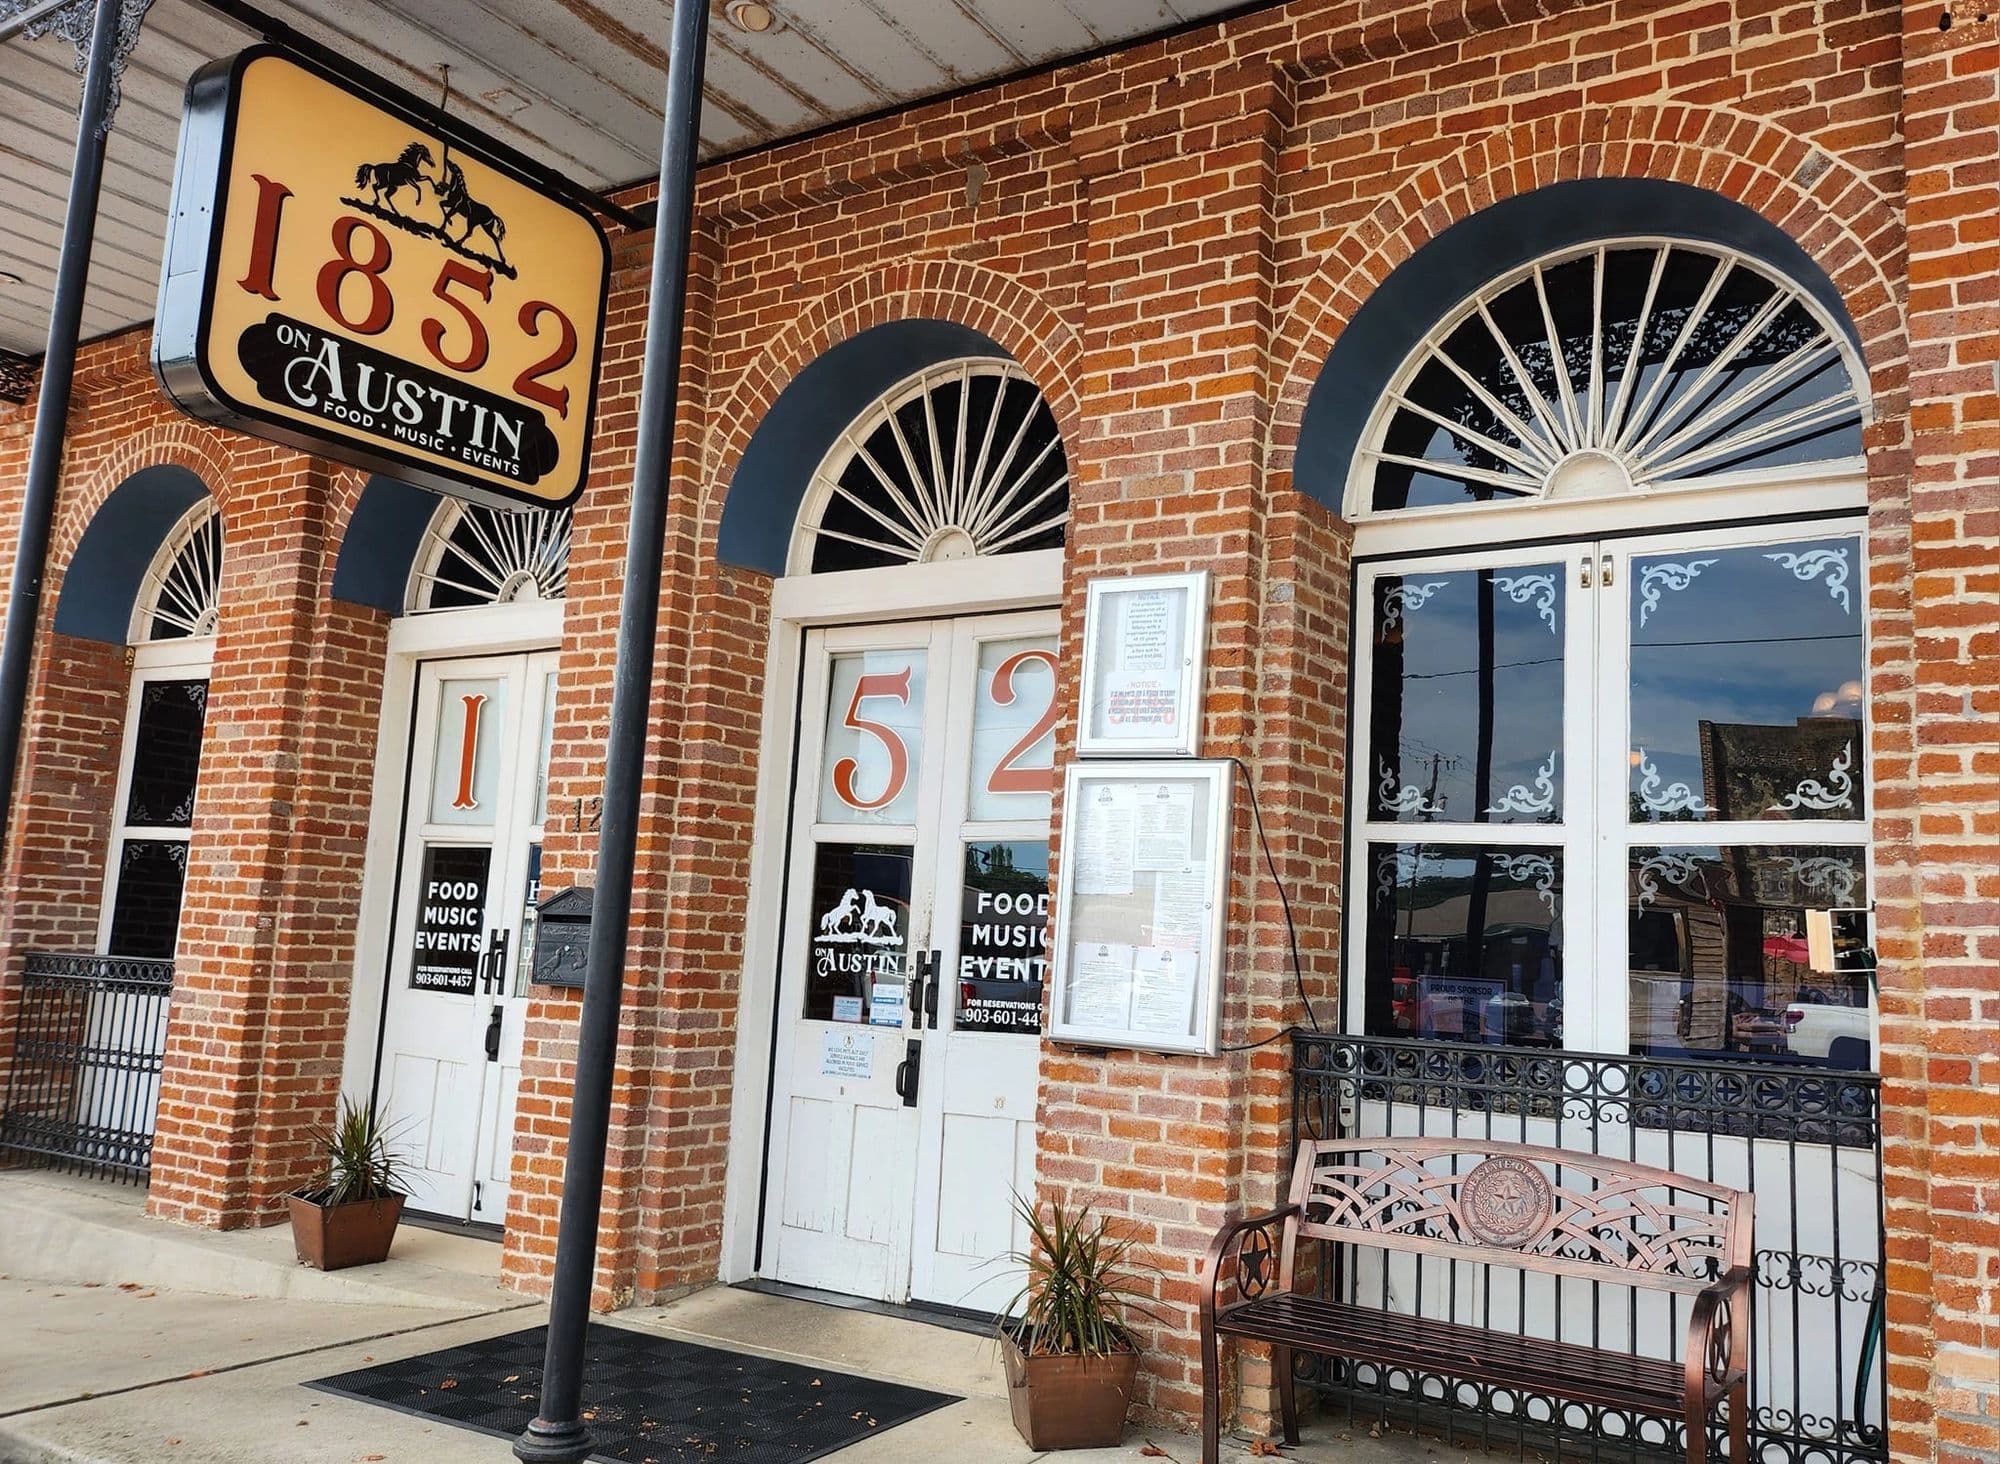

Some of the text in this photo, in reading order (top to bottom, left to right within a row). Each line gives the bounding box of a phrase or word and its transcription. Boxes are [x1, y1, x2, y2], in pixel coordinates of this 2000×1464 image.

[236, 174, 577, 420] 1852
[276, 324, 525, 461] ON AUSTIN
[324, 401, 520, 476] FOOD MUSIC EVENTS
[428, 881, 478, 900] FOOD
[977, 893, 1049, 916] FOOD
[424, 906, 478, 926] MUSIC
[415, 931, 481, 952] EVENTS
[815, 948, 899, 977] ON AUSTIN
[415, 973, 473, 987] 903-601-4457
[1430, 983, 1493, 995] PROUD SPONSOR
[983, 1000, 1036, 1010] RESERVATIONS
[1477, 1160, 1512, 1177] STATE
